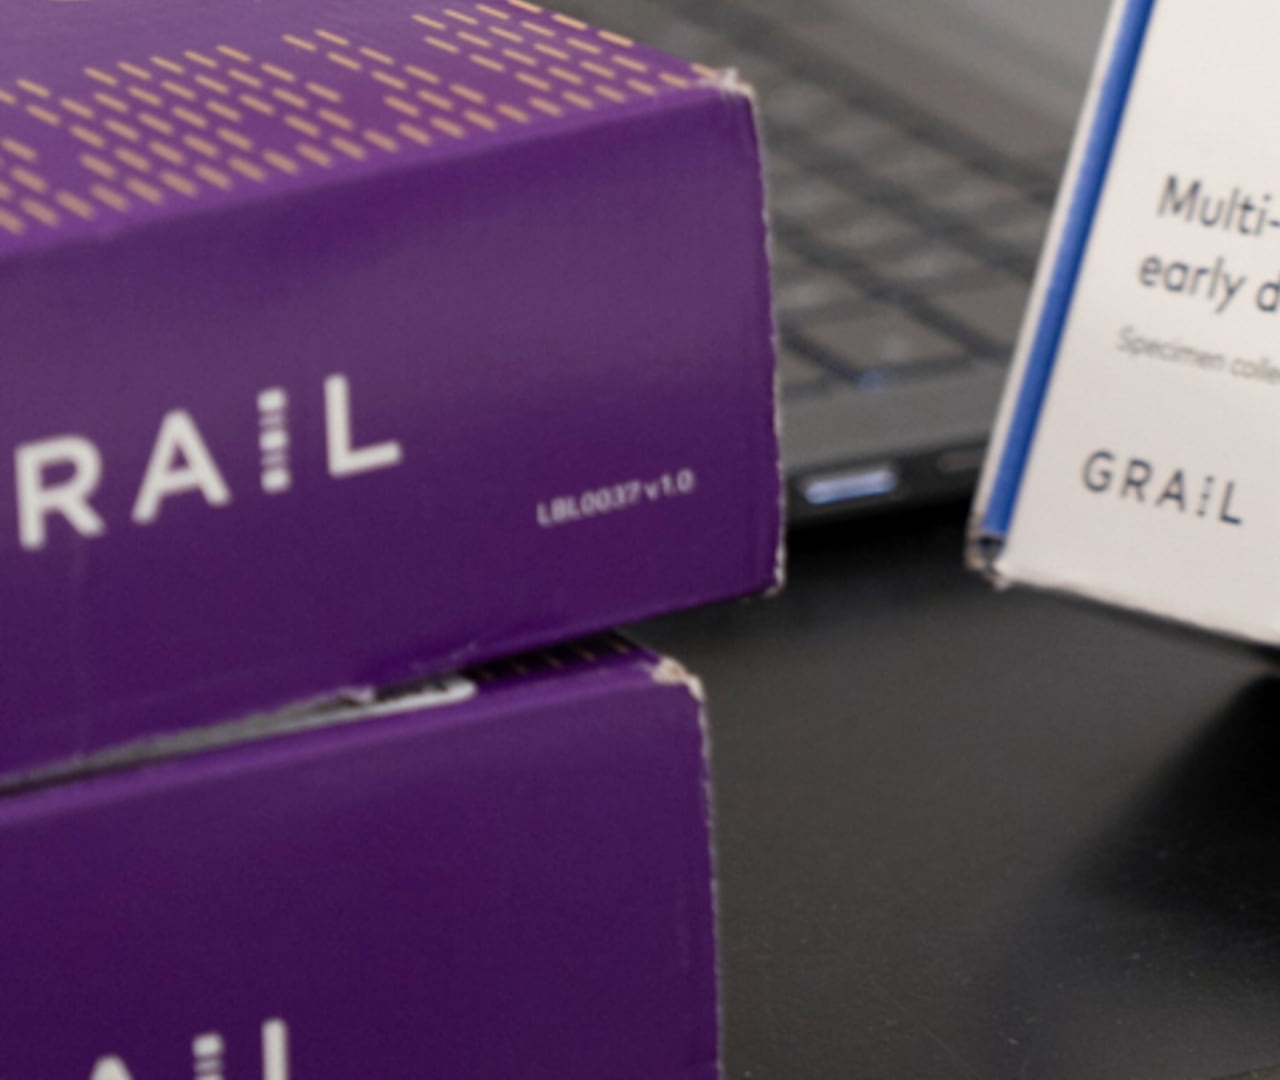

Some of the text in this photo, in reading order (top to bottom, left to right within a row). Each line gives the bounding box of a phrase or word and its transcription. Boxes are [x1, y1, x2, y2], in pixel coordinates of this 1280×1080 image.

[1138, 247, 1245, 315] early
[1117, 325, 1226, 371] Specimen
[1082, 451, 1243, 526] GRAIL
